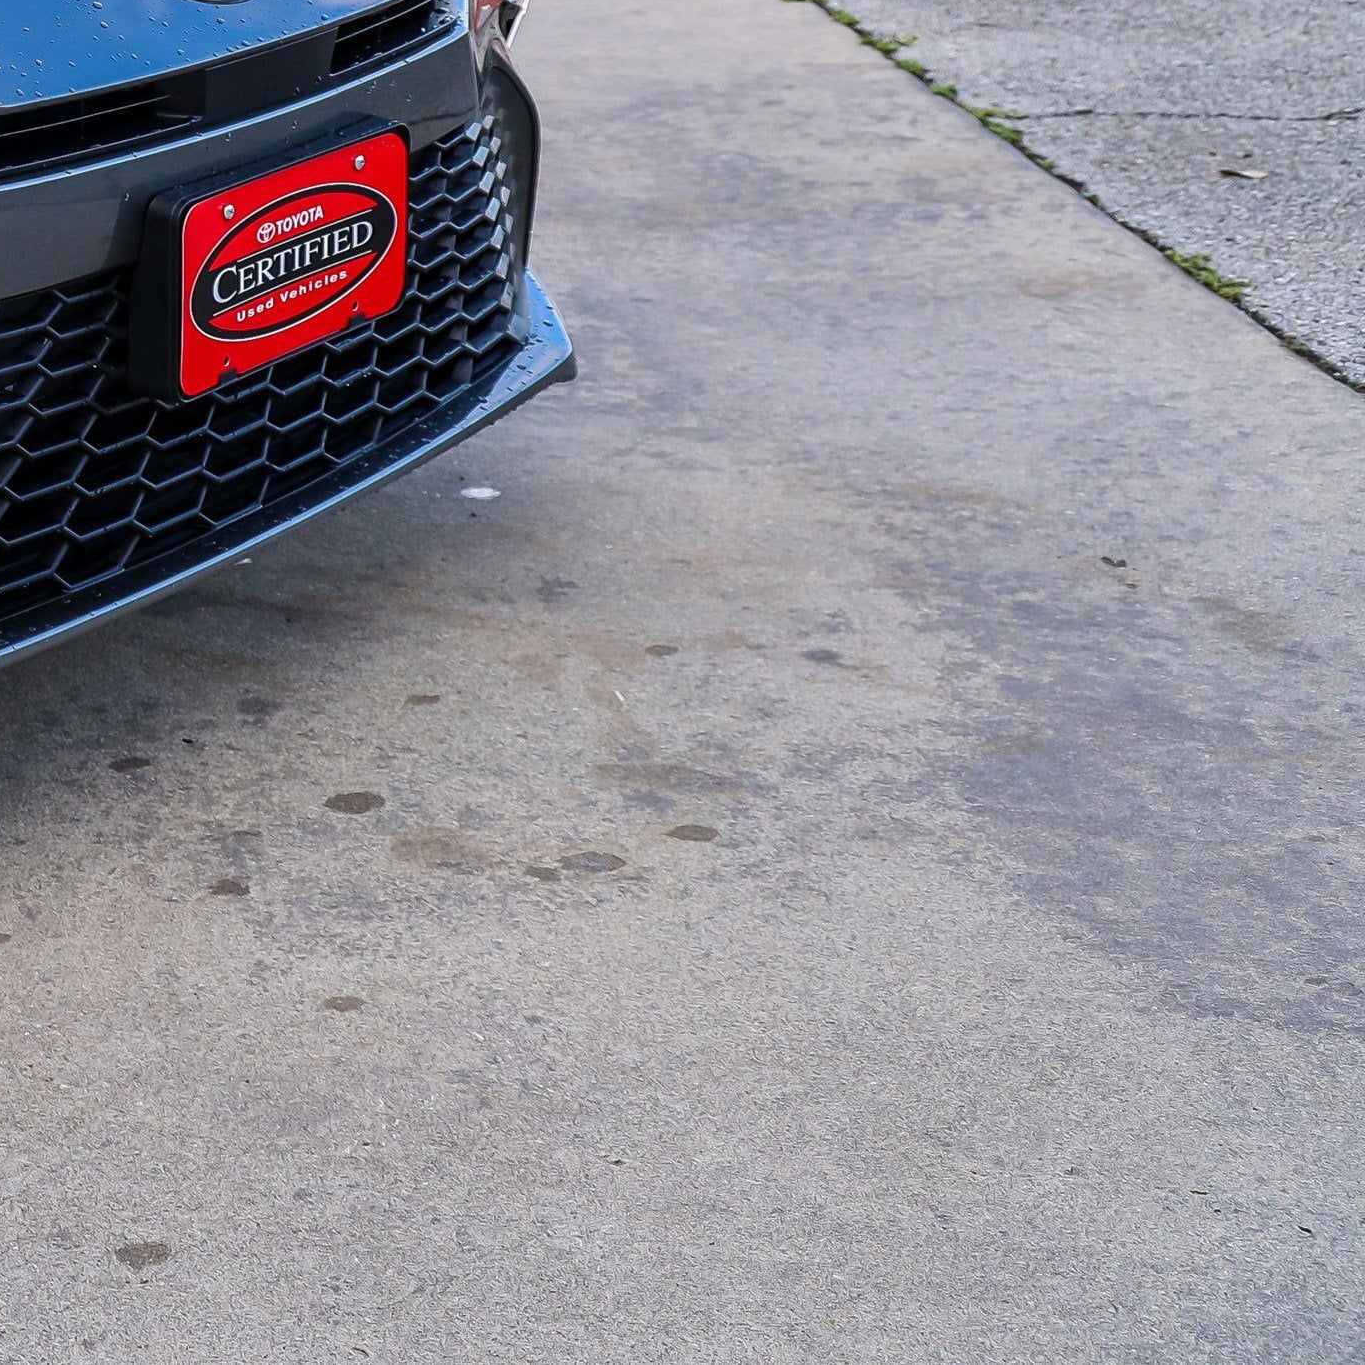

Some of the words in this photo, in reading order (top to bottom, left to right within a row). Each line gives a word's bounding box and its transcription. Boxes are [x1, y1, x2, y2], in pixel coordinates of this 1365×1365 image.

[276, 206, 324, 235] TOYOTA
[213, 221, 373, 303] CERTIFIED
[236, 297, 274, 322] Used
[280, 270, 348, 303] Vehicles
